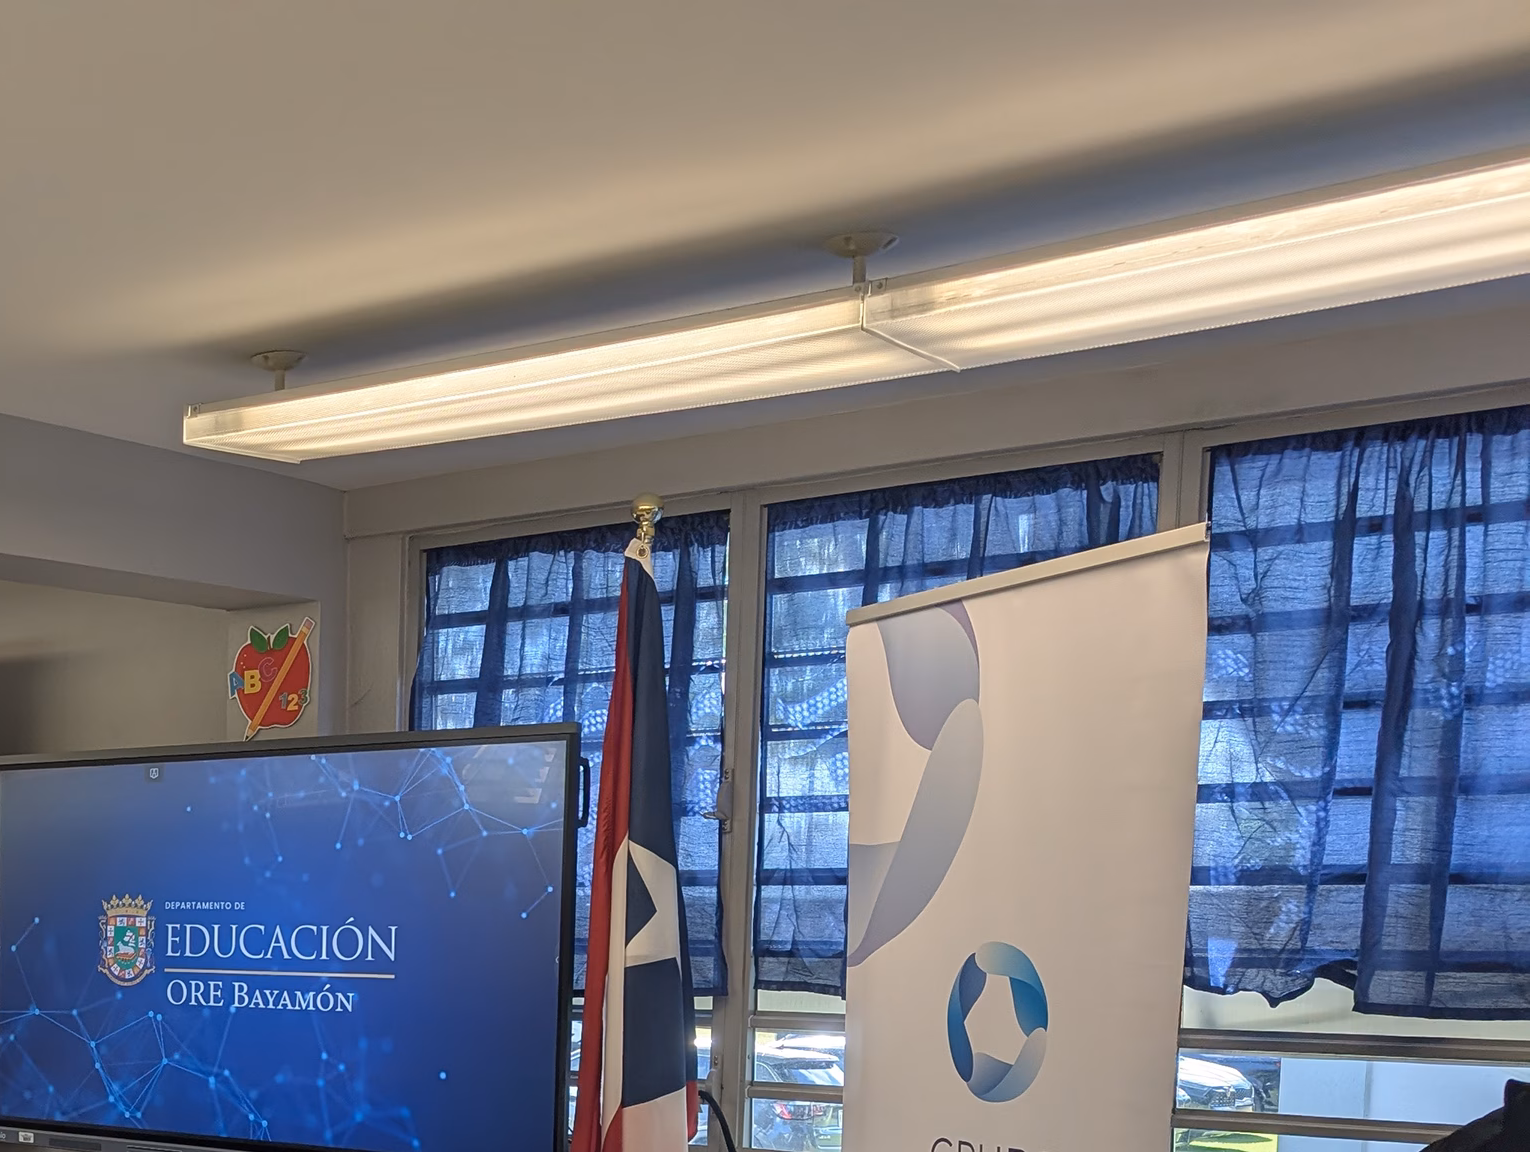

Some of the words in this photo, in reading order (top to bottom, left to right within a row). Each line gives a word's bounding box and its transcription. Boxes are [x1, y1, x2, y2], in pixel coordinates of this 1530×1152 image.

[279, 688, 310, 711] 123
[164, 901, 232, 910] DEPARTAMENTO
[234, 901, 246, 910] DE
[165, 916, 399, 962] EDUCACIÓN
[166, 979, 224, 1007] ORE
